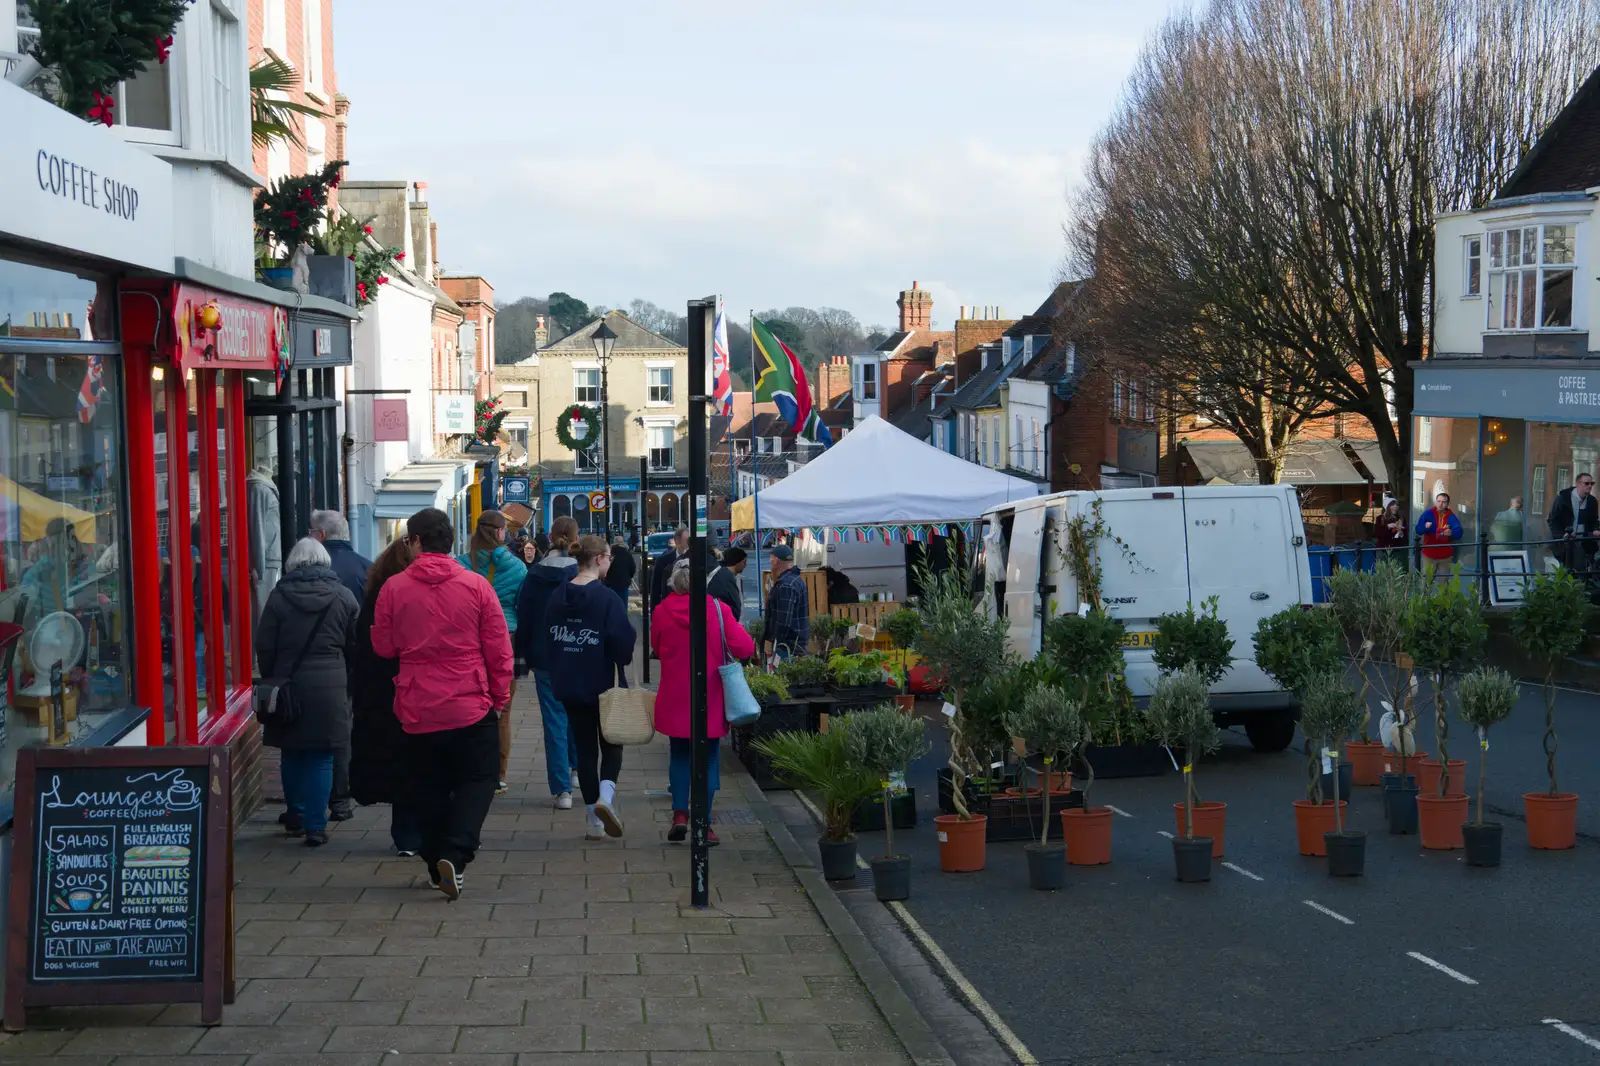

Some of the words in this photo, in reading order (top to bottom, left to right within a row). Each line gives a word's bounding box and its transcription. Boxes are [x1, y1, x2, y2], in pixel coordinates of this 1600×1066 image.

[37, 149, 100, 210] COFFEE
[104, 176, 139, 222] SHOP
[1558, 376, 1586, 389] COFFEE
[1558, 391, 1564, 404] &
[549, 625, 577, 643] White
[576, 628, 600, 646] Fox
[44, 775, 164, 819] Lounges
[89, 809, 131, 818] COFFEE
[138, 808, 165, 818] SHOP
[124, 824, 148, 833] FULL
[150, 824, 192, 833] ENGLISH
[51, 834, 109, 850] SALADS
[123, 833, 190, 845] BREAKFASTS
[56, 853, 108, 869] SANDWICHES
[121, 868, 190, 880] BAGUETTES
[54, 873, 108, 890] SOUPS
[121, 882, 189, 896] PANINIS
[121, 897, 151, 905] JACKET
[151, 896, 188, 904] POTATOES
[121, 906, 157, 914] CHILD'S
[162, 905, 188, 913] MENU
[51, 918, 89, 933] GLUTEN
[90, 920, 98, 930] &
[99, 919, 128, 930] DAIRY
[129, 918, 151, 929] FREE
[48, 939, 73, 956] EAT
[76, 939, 92, 955] IN
[94, 941, 112, 953] AND
[115, 937, 144, 955] TAKE
[146, 938, 184, 954] AWAY
[44, 961, 63, 969] DOGS
[66, 961, 100, 969] WELCOME
[170, 959, 187, 967] WIFI
